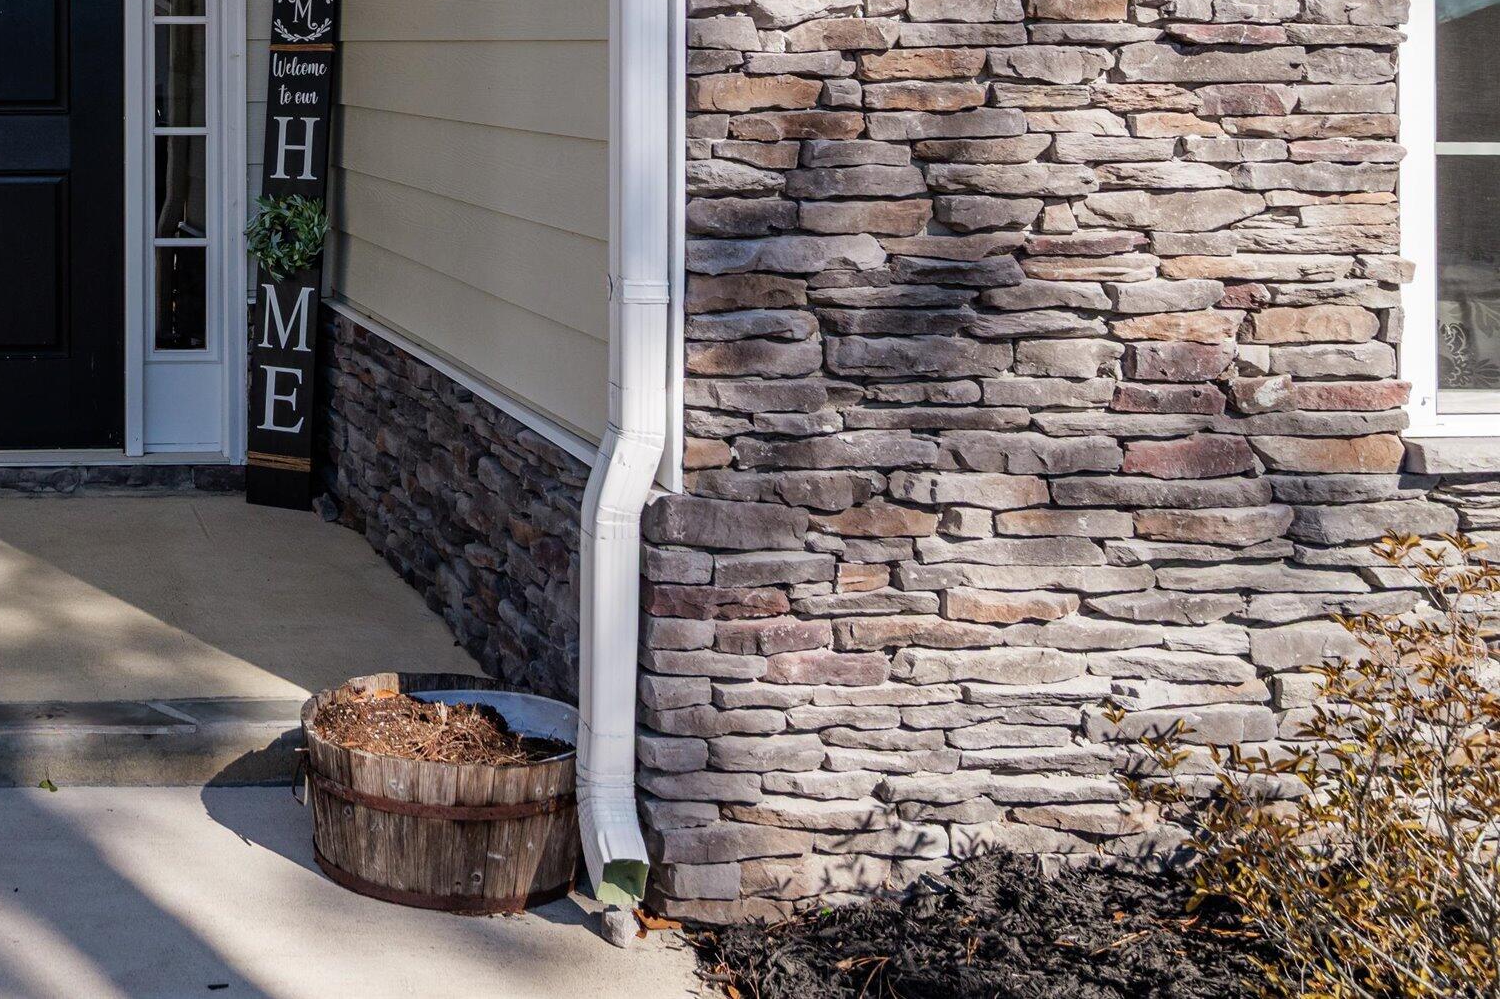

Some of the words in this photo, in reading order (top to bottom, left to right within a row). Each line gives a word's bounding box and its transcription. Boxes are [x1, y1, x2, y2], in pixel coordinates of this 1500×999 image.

[273, 53, 327, 77] Welcome
[278, 84, 292, 105] to
[295, 91, 318, 104] our
